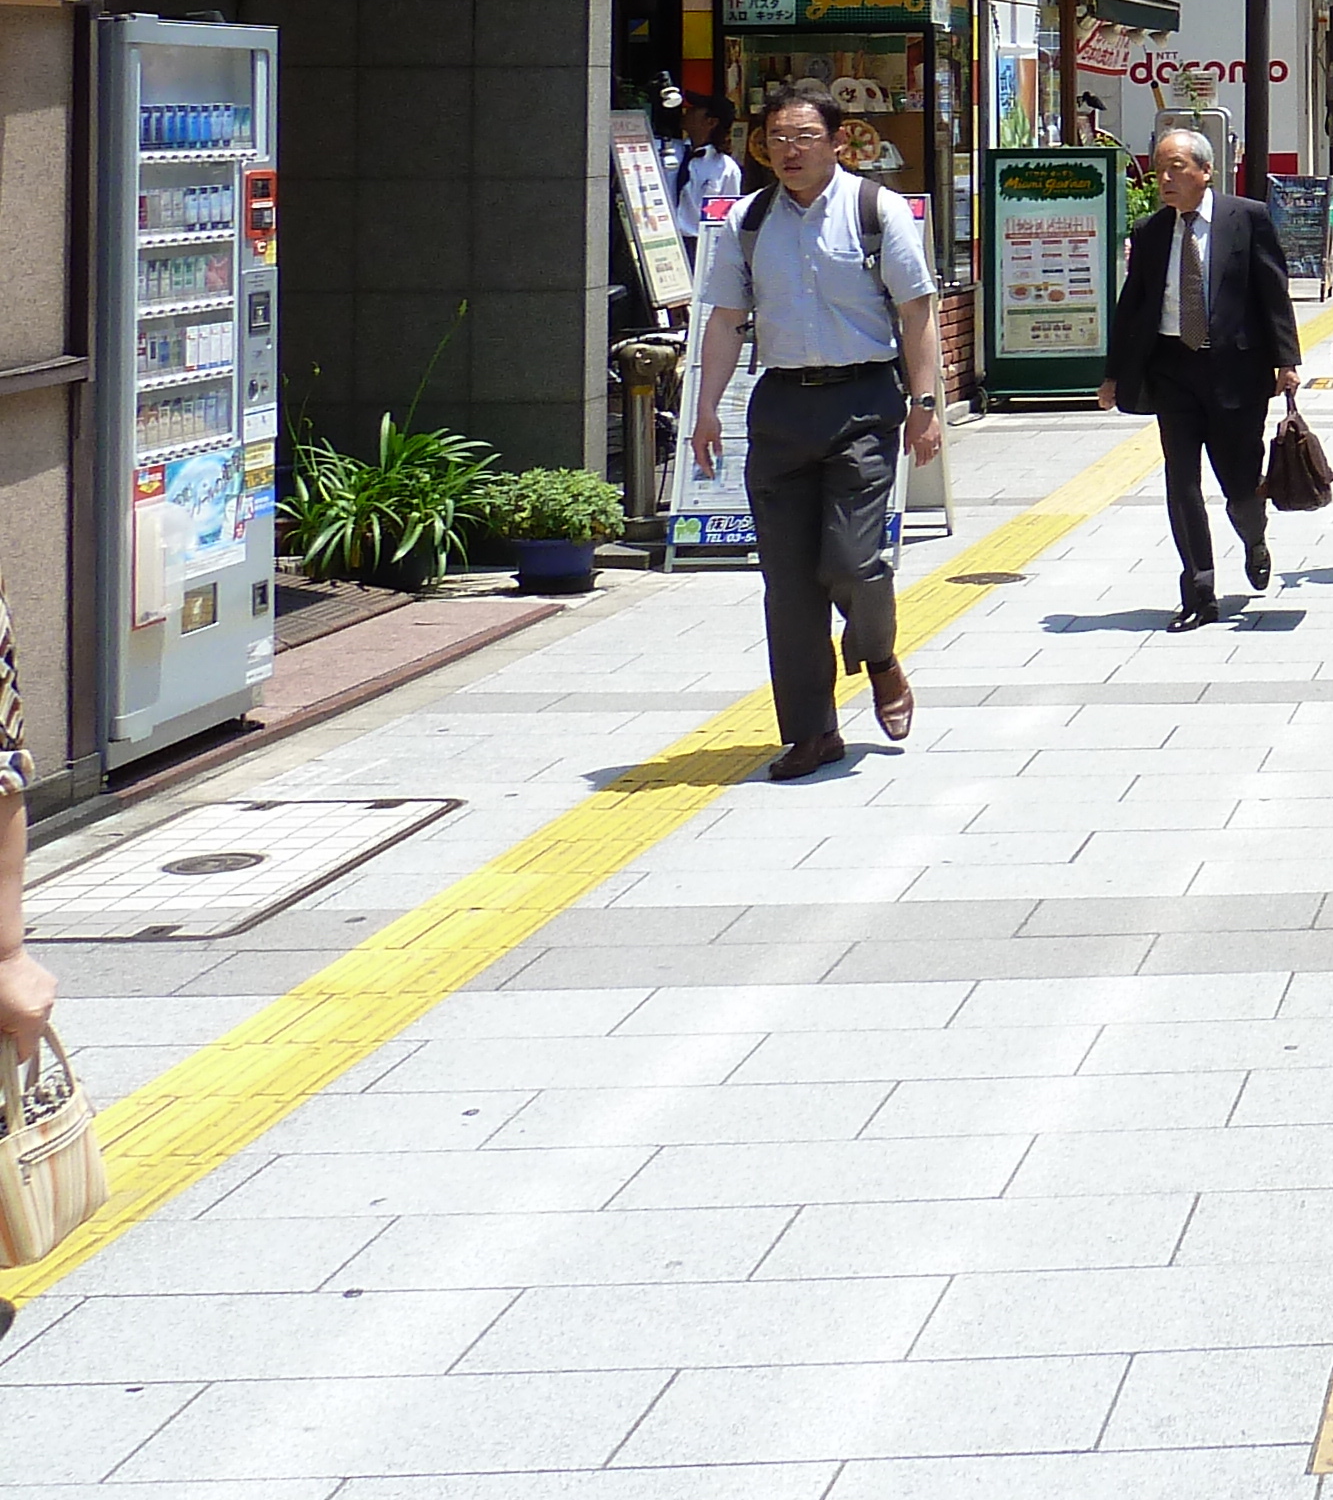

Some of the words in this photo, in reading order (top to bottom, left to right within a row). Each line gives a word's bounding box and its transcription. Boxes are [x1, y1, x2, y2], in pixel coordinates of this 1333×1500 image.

[728, 10, 748, 22] 入口
[756, 10, 794, 22] キッチン
[1156, 52, 1178, 60] NTT
[1004, 176, 1042, 190] Miami
[706, 532, 724, 544] TEL
